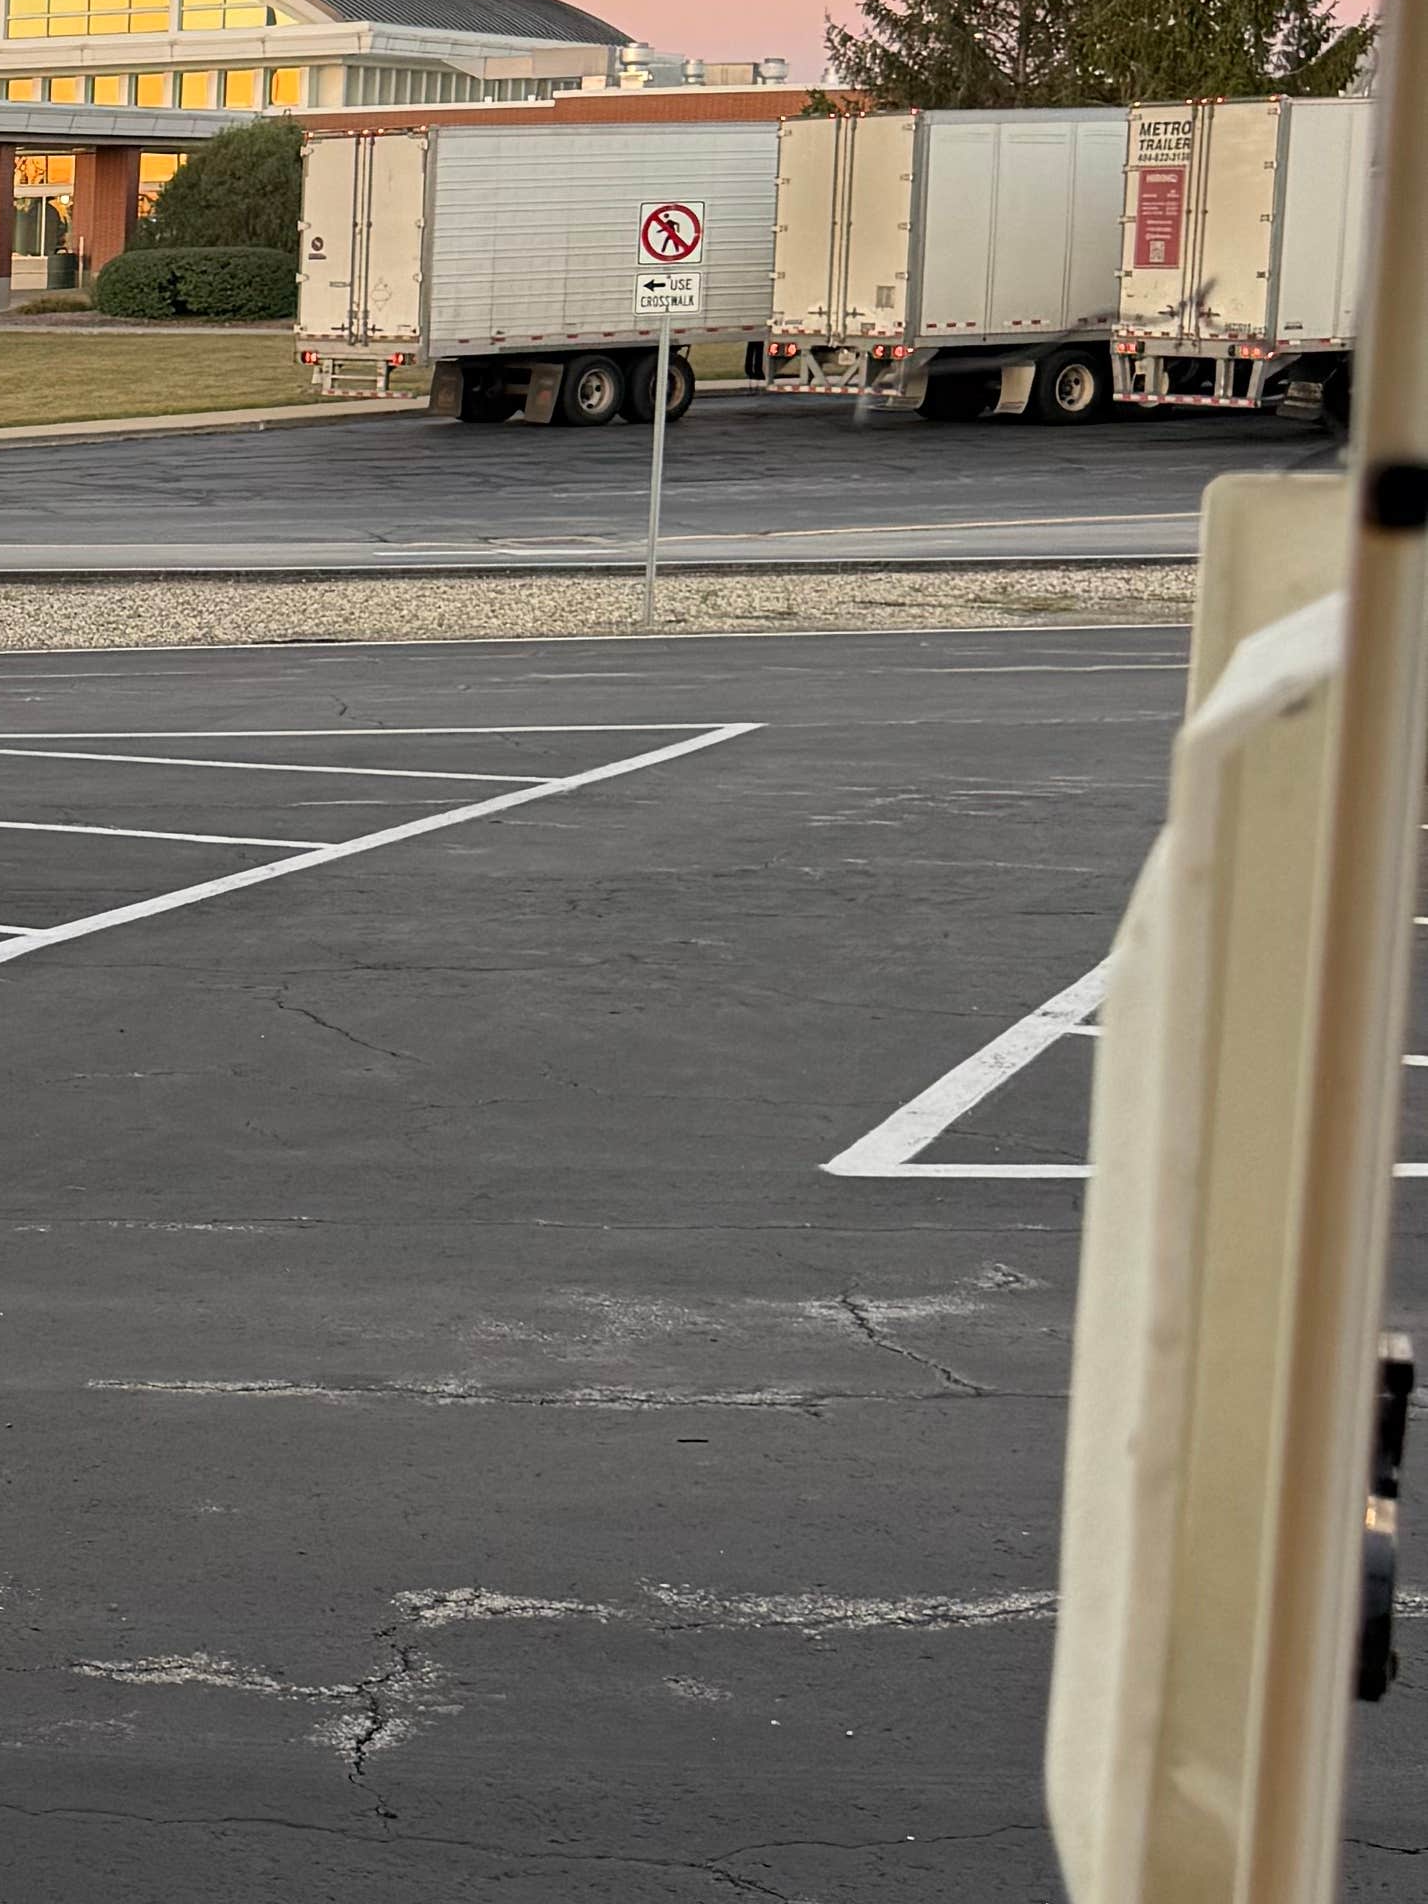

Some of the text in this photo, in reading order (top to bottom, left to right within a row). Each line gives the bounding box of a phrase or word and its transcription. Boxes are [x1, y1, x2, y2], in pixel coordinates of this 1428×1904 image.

[1139, 120, 1193, 136] METRO
[1139, 138, 1191, 151] TRAILER
[670, 278, 693, 290] USE
[640, 296, 694, 307] CROSSWALK
